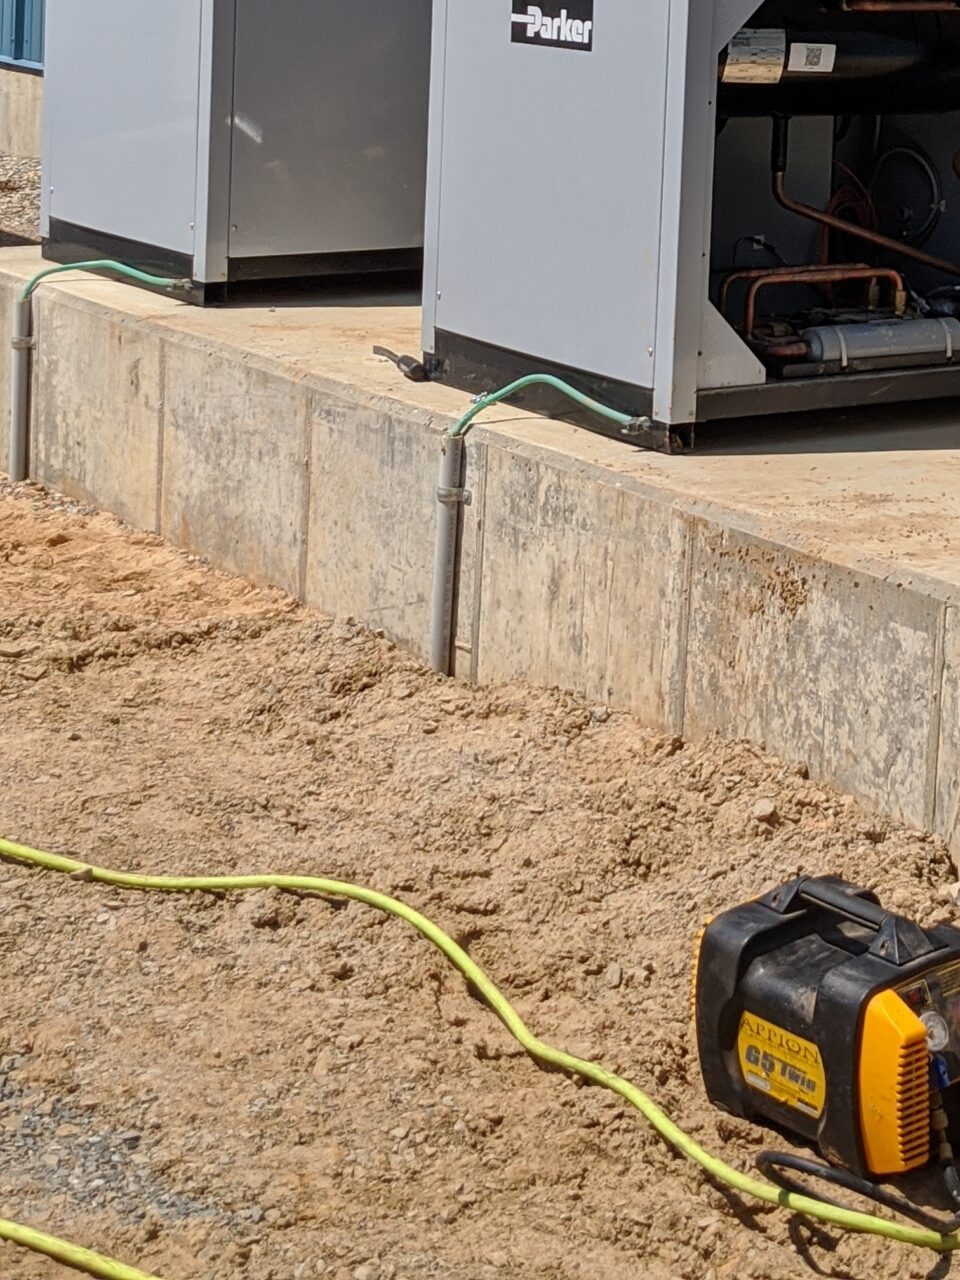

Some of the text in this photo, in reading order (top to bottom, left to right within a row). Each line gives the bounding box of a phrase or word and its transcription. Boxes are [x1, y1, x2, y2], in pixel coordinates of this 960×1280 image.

[526, 5, 593, 43] Parker
[741, 1017, 819, 1064] APPION
[745, 1044, 776, 1073] G5
